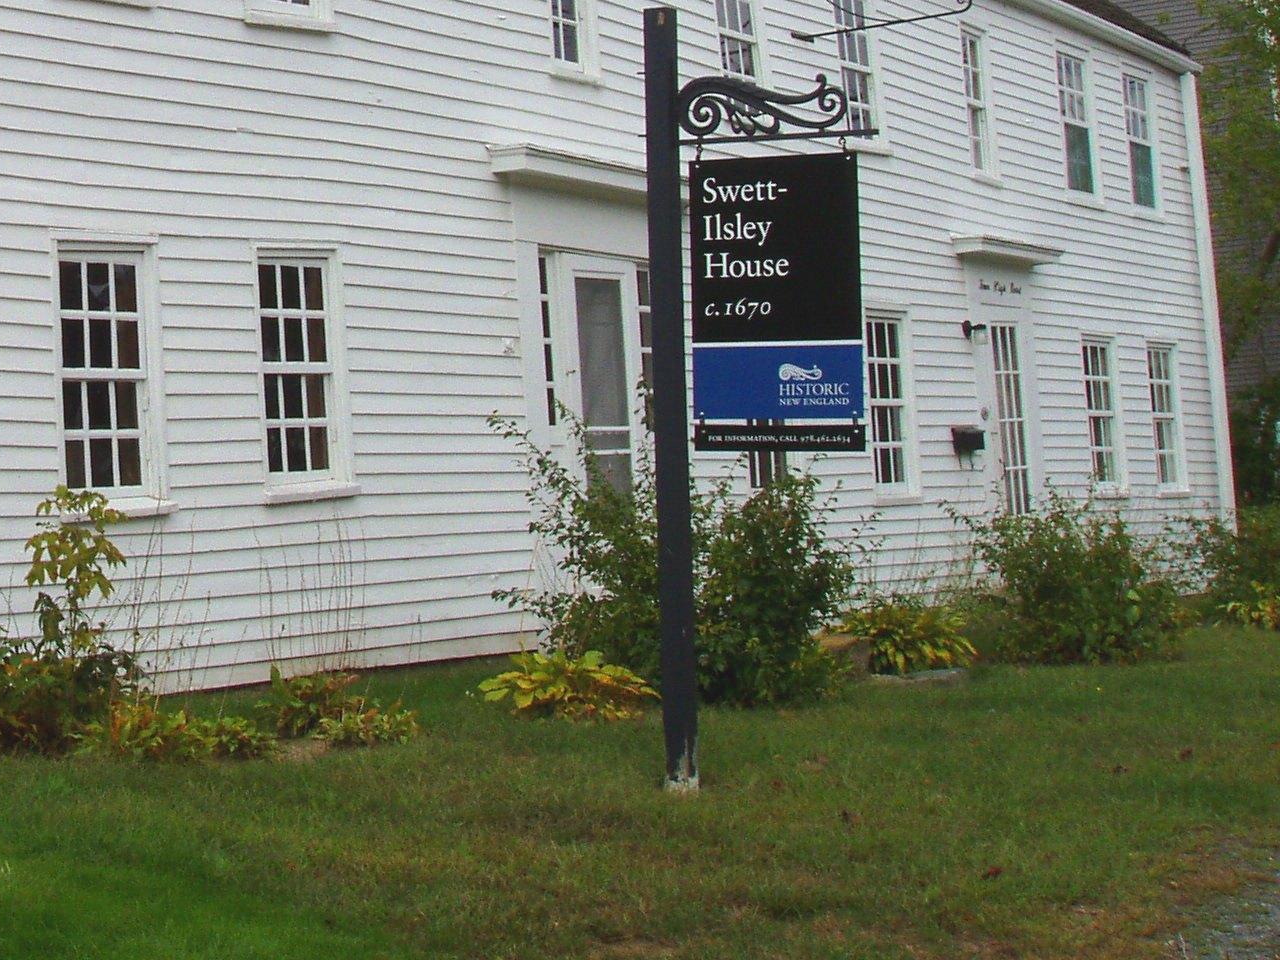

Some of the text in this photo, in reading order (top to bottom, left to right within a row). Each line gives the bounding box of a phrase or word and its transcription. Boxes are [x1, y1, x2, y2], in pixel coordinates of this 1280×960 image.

[702, 177, 788, 203] Swett-
[703, 213, 772, 246] Ilsley
[703, 252, 790, 278] House
[779, 383, 850, 396] HISTORIC
[779, 397, 850, 406] NEW ENGLAND
[708, 434, 722, 443] FOR
[779, 434, 797, 442] CALL
